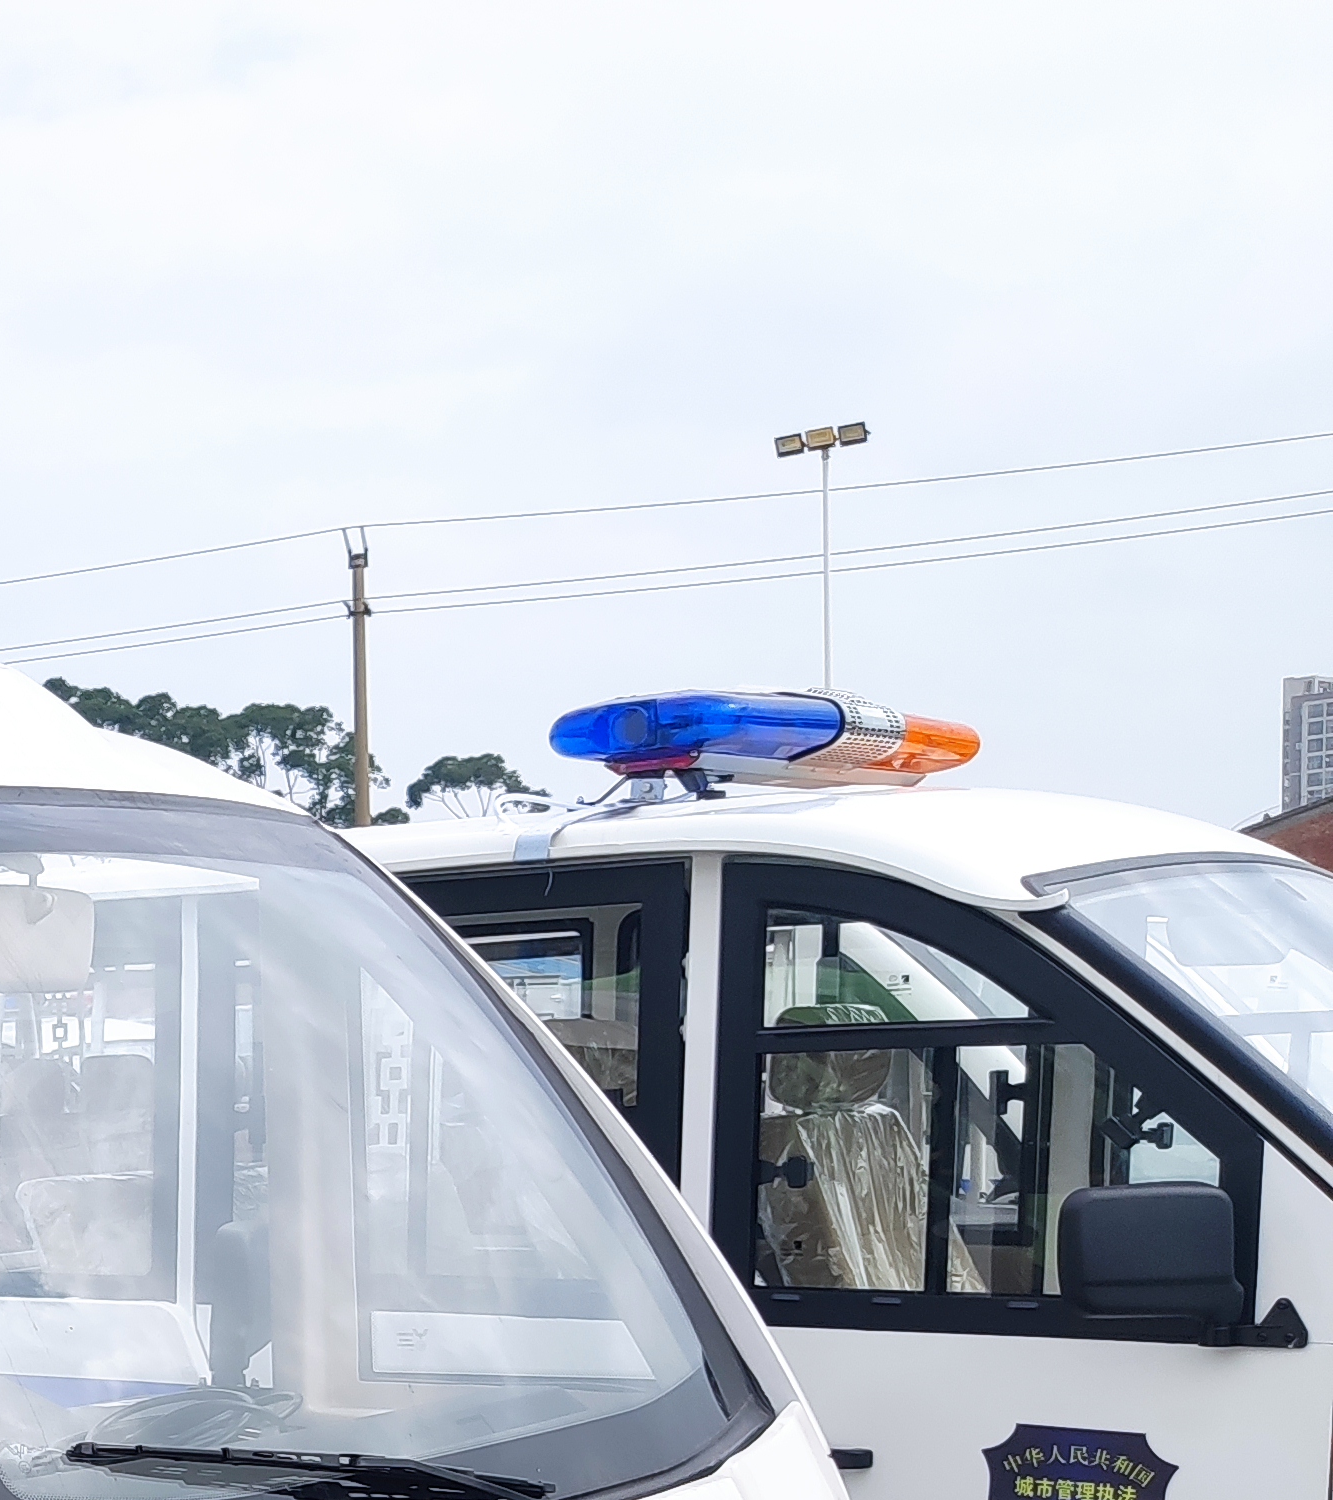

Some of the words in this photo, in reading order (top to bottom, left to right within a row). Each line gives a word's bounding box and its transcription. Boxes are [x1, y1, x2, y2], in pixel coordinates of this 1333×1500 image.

[1002, 1444, 1156, 1488] 中华人民共和国
